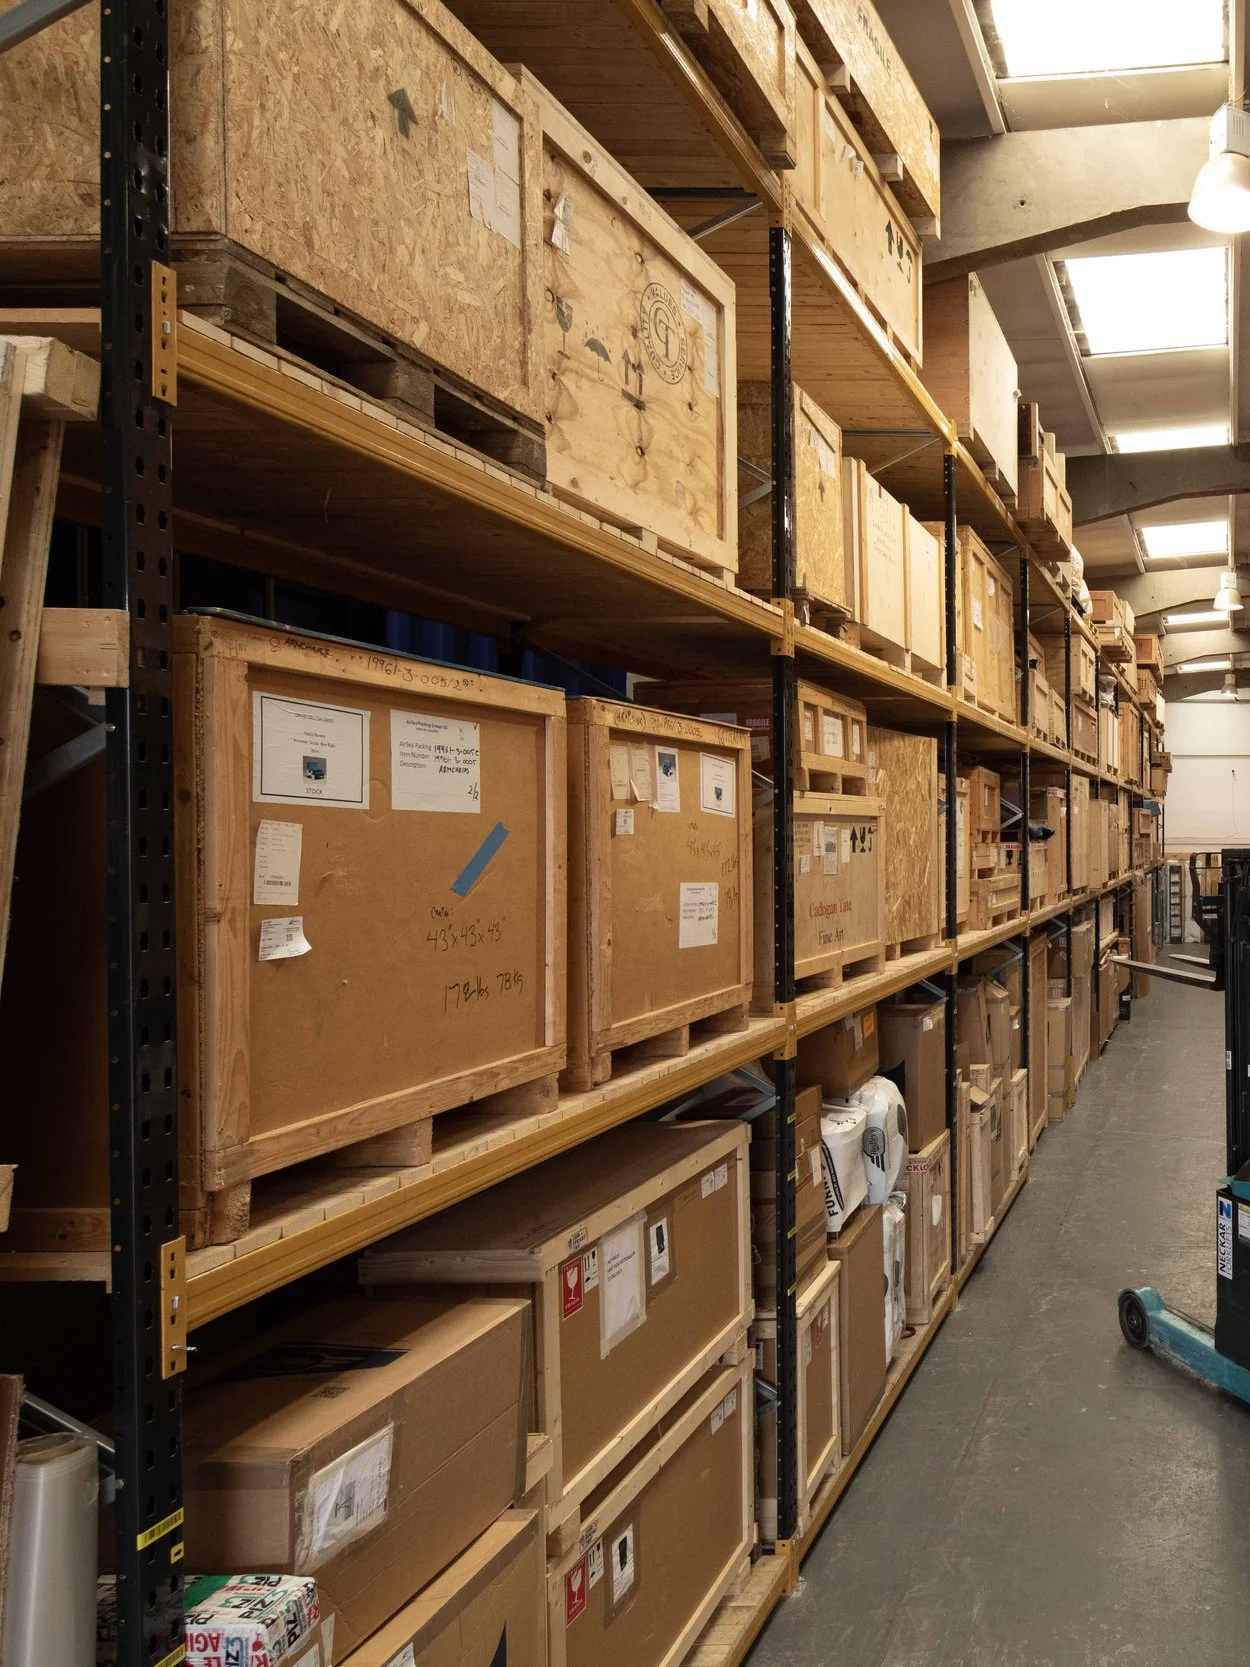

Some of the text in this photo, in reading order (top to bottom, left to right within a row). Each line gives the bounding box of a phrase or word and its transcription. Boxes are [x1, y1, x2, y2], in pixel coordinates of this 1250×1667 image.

[809, 899, 852, 919] Cadogan Tate
[818, 927, 845, 946] Fine Art
